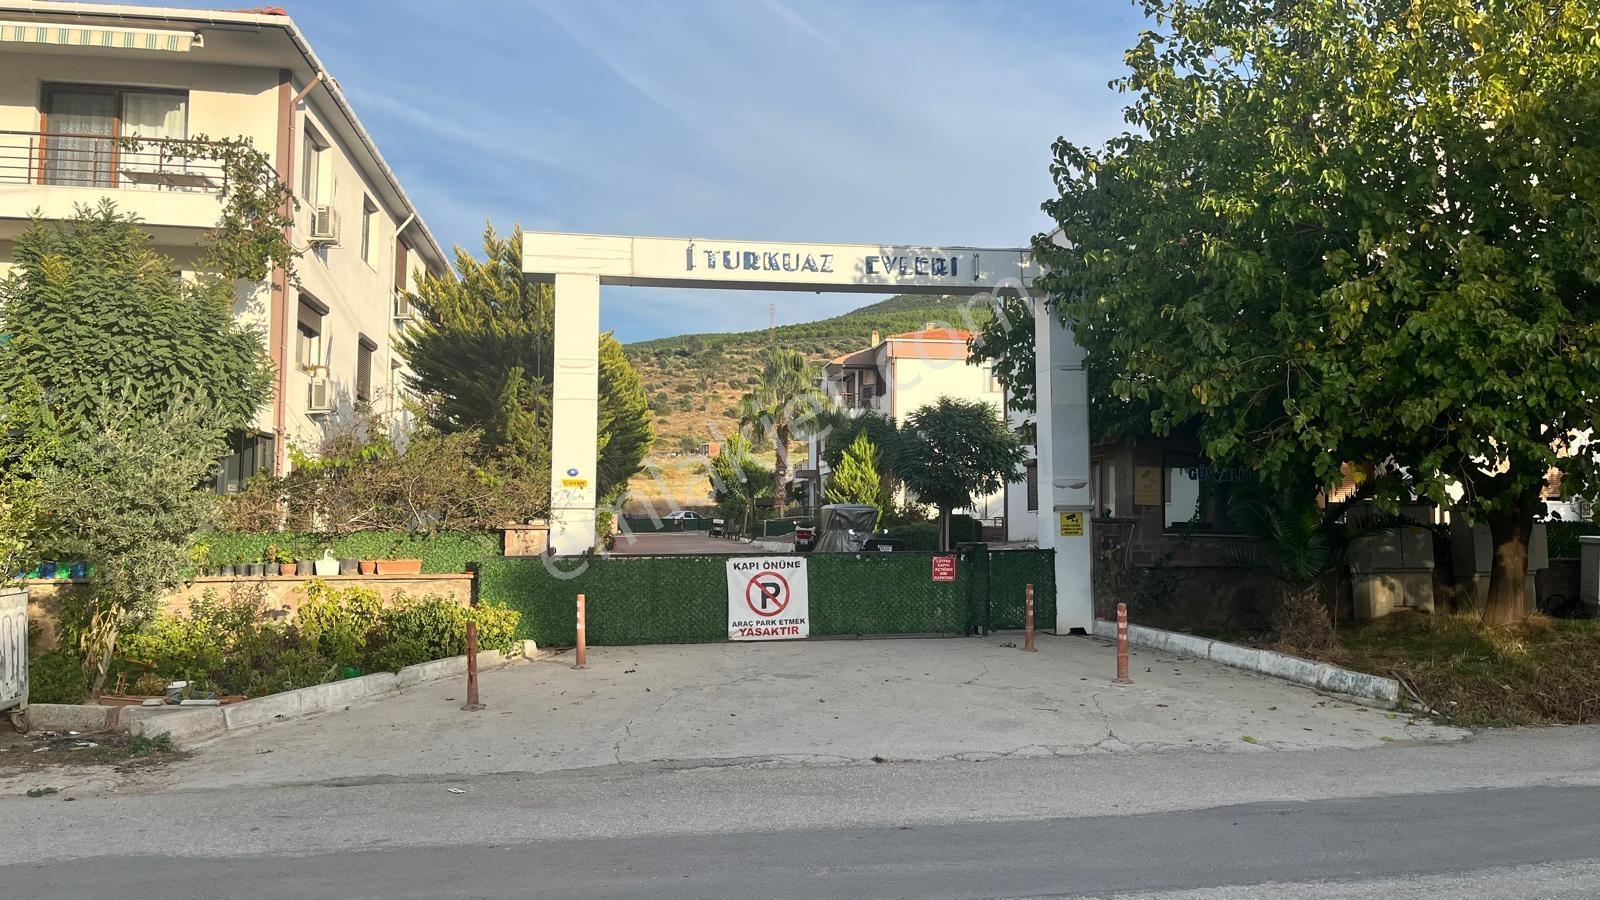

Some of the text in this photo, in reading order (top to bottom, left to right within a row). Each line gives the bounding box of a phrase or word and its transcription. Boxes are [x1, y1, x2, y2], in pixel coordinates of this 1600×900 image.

[733, 560, 801, 570] KAPI ÖNÜNE
[739, 626, 799, 637] YASAKTIR
